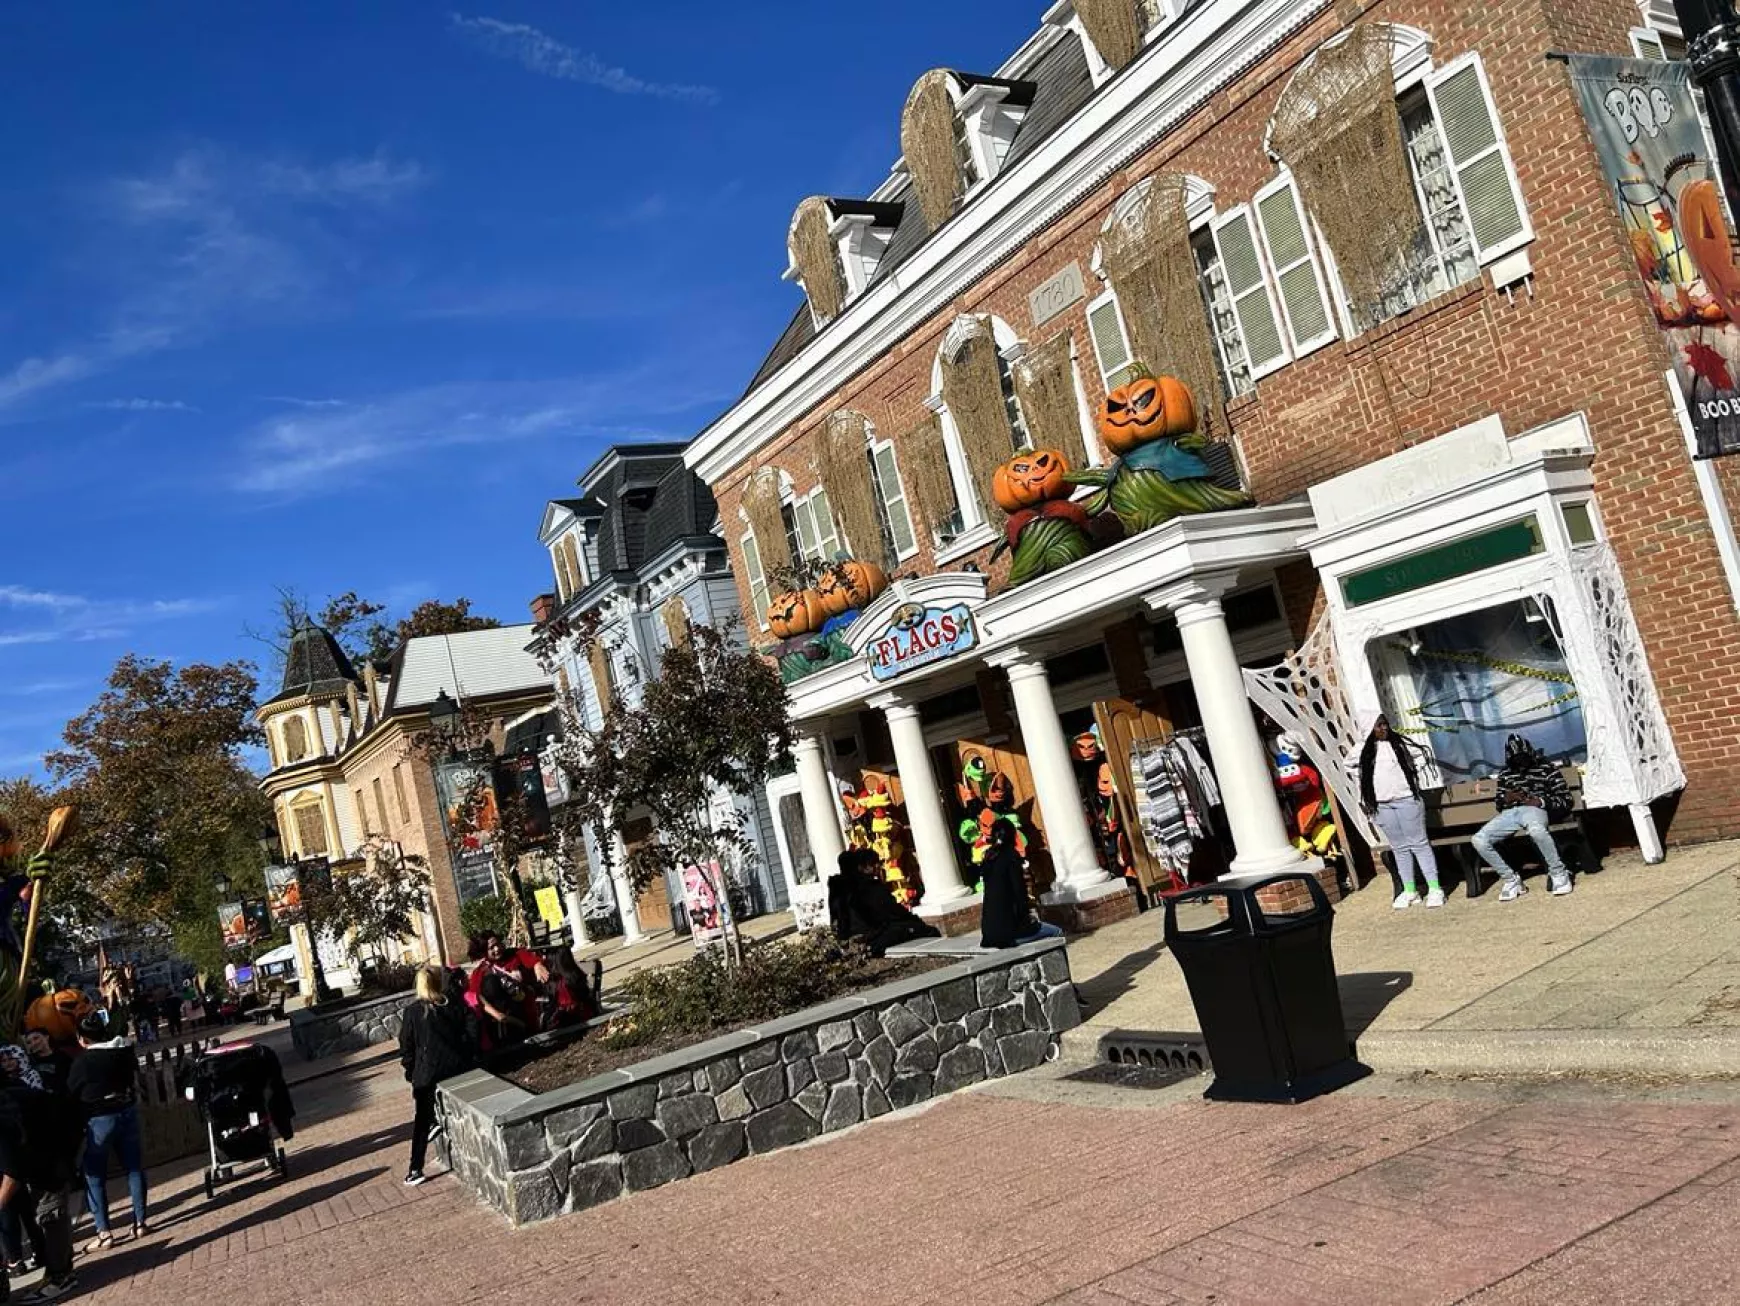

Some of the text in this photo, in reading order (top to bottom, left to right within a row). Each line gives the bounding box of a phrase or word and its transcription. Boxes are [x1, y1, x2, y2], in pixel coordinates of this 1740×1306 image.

[1603, 86, 1672, 144] BOO
[1698, 397, 1740, 418] BOO B
[877, 615, 957, 667] FLAGS
